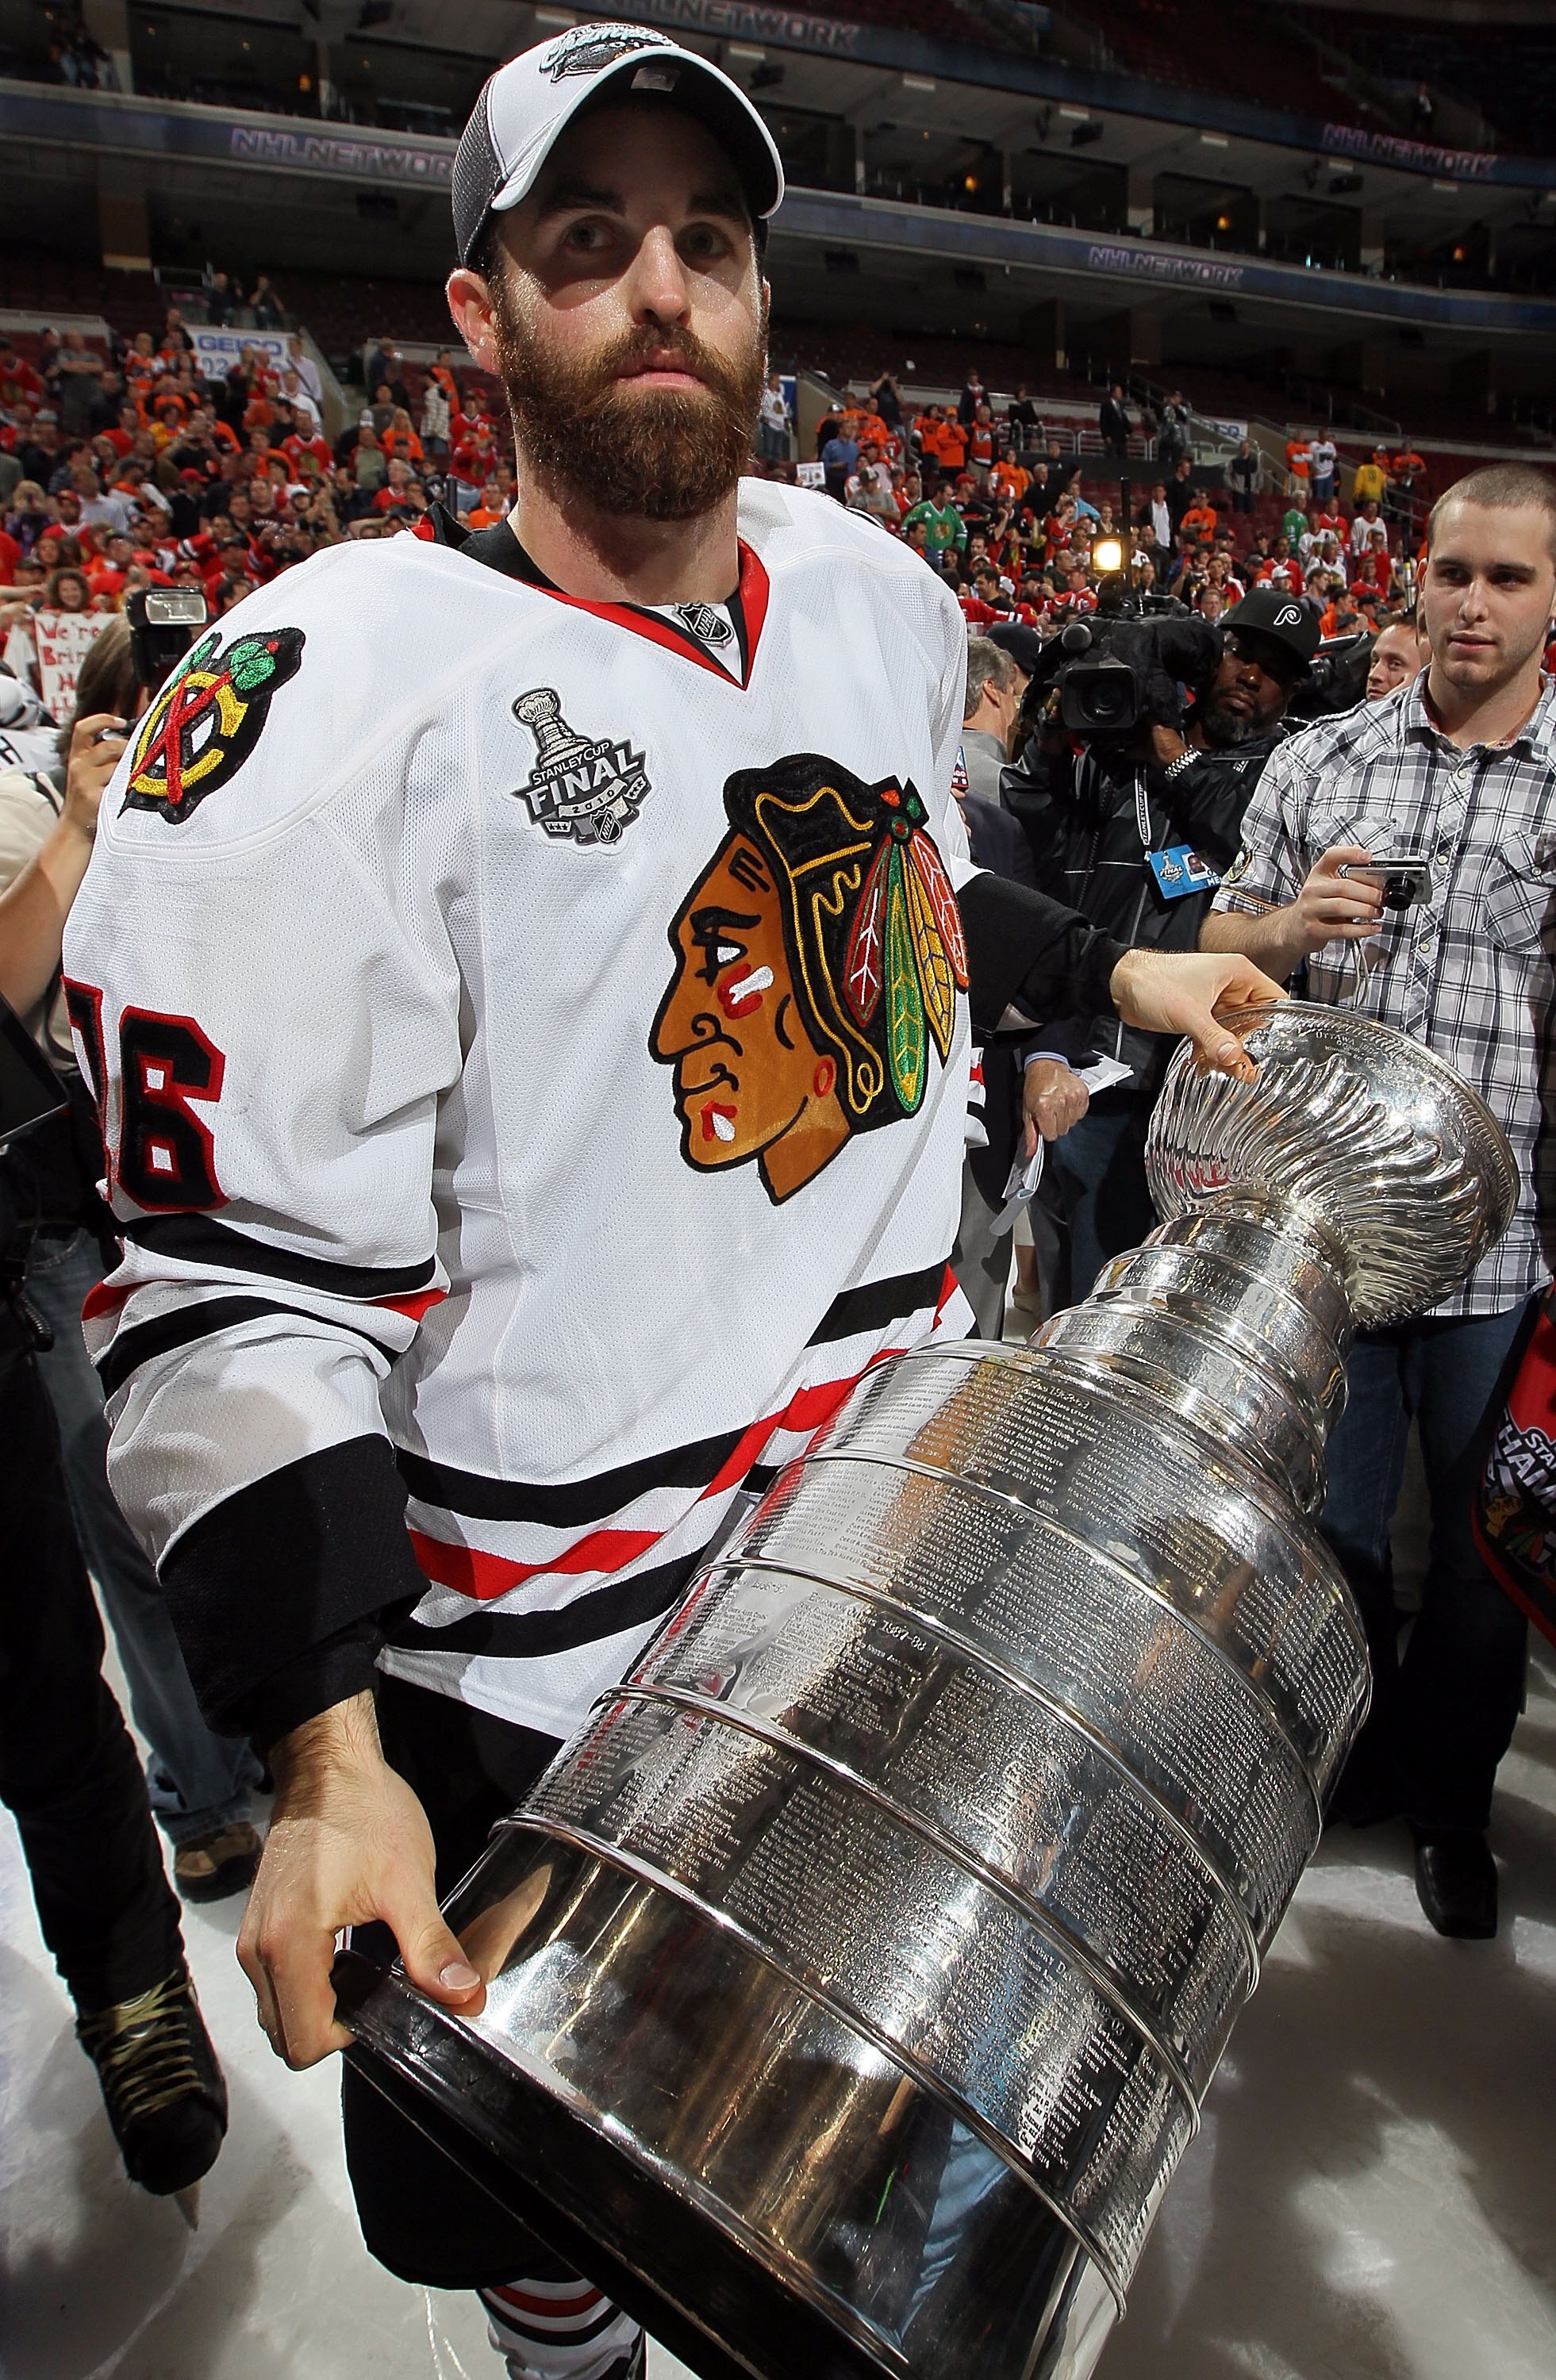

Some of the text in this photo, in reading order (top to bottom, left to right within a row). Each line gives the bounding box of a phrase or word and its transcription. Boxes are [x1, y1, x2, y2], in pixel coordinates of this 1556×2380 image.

[532, 741, 610, 785] STANLEY CUP
[525, 749, 640, 816] FINAL
[571, 789, 616, 815] 2010
[1159, 866, 1184, 876] FINAL
[1206, 876, 1221, 886] ME
